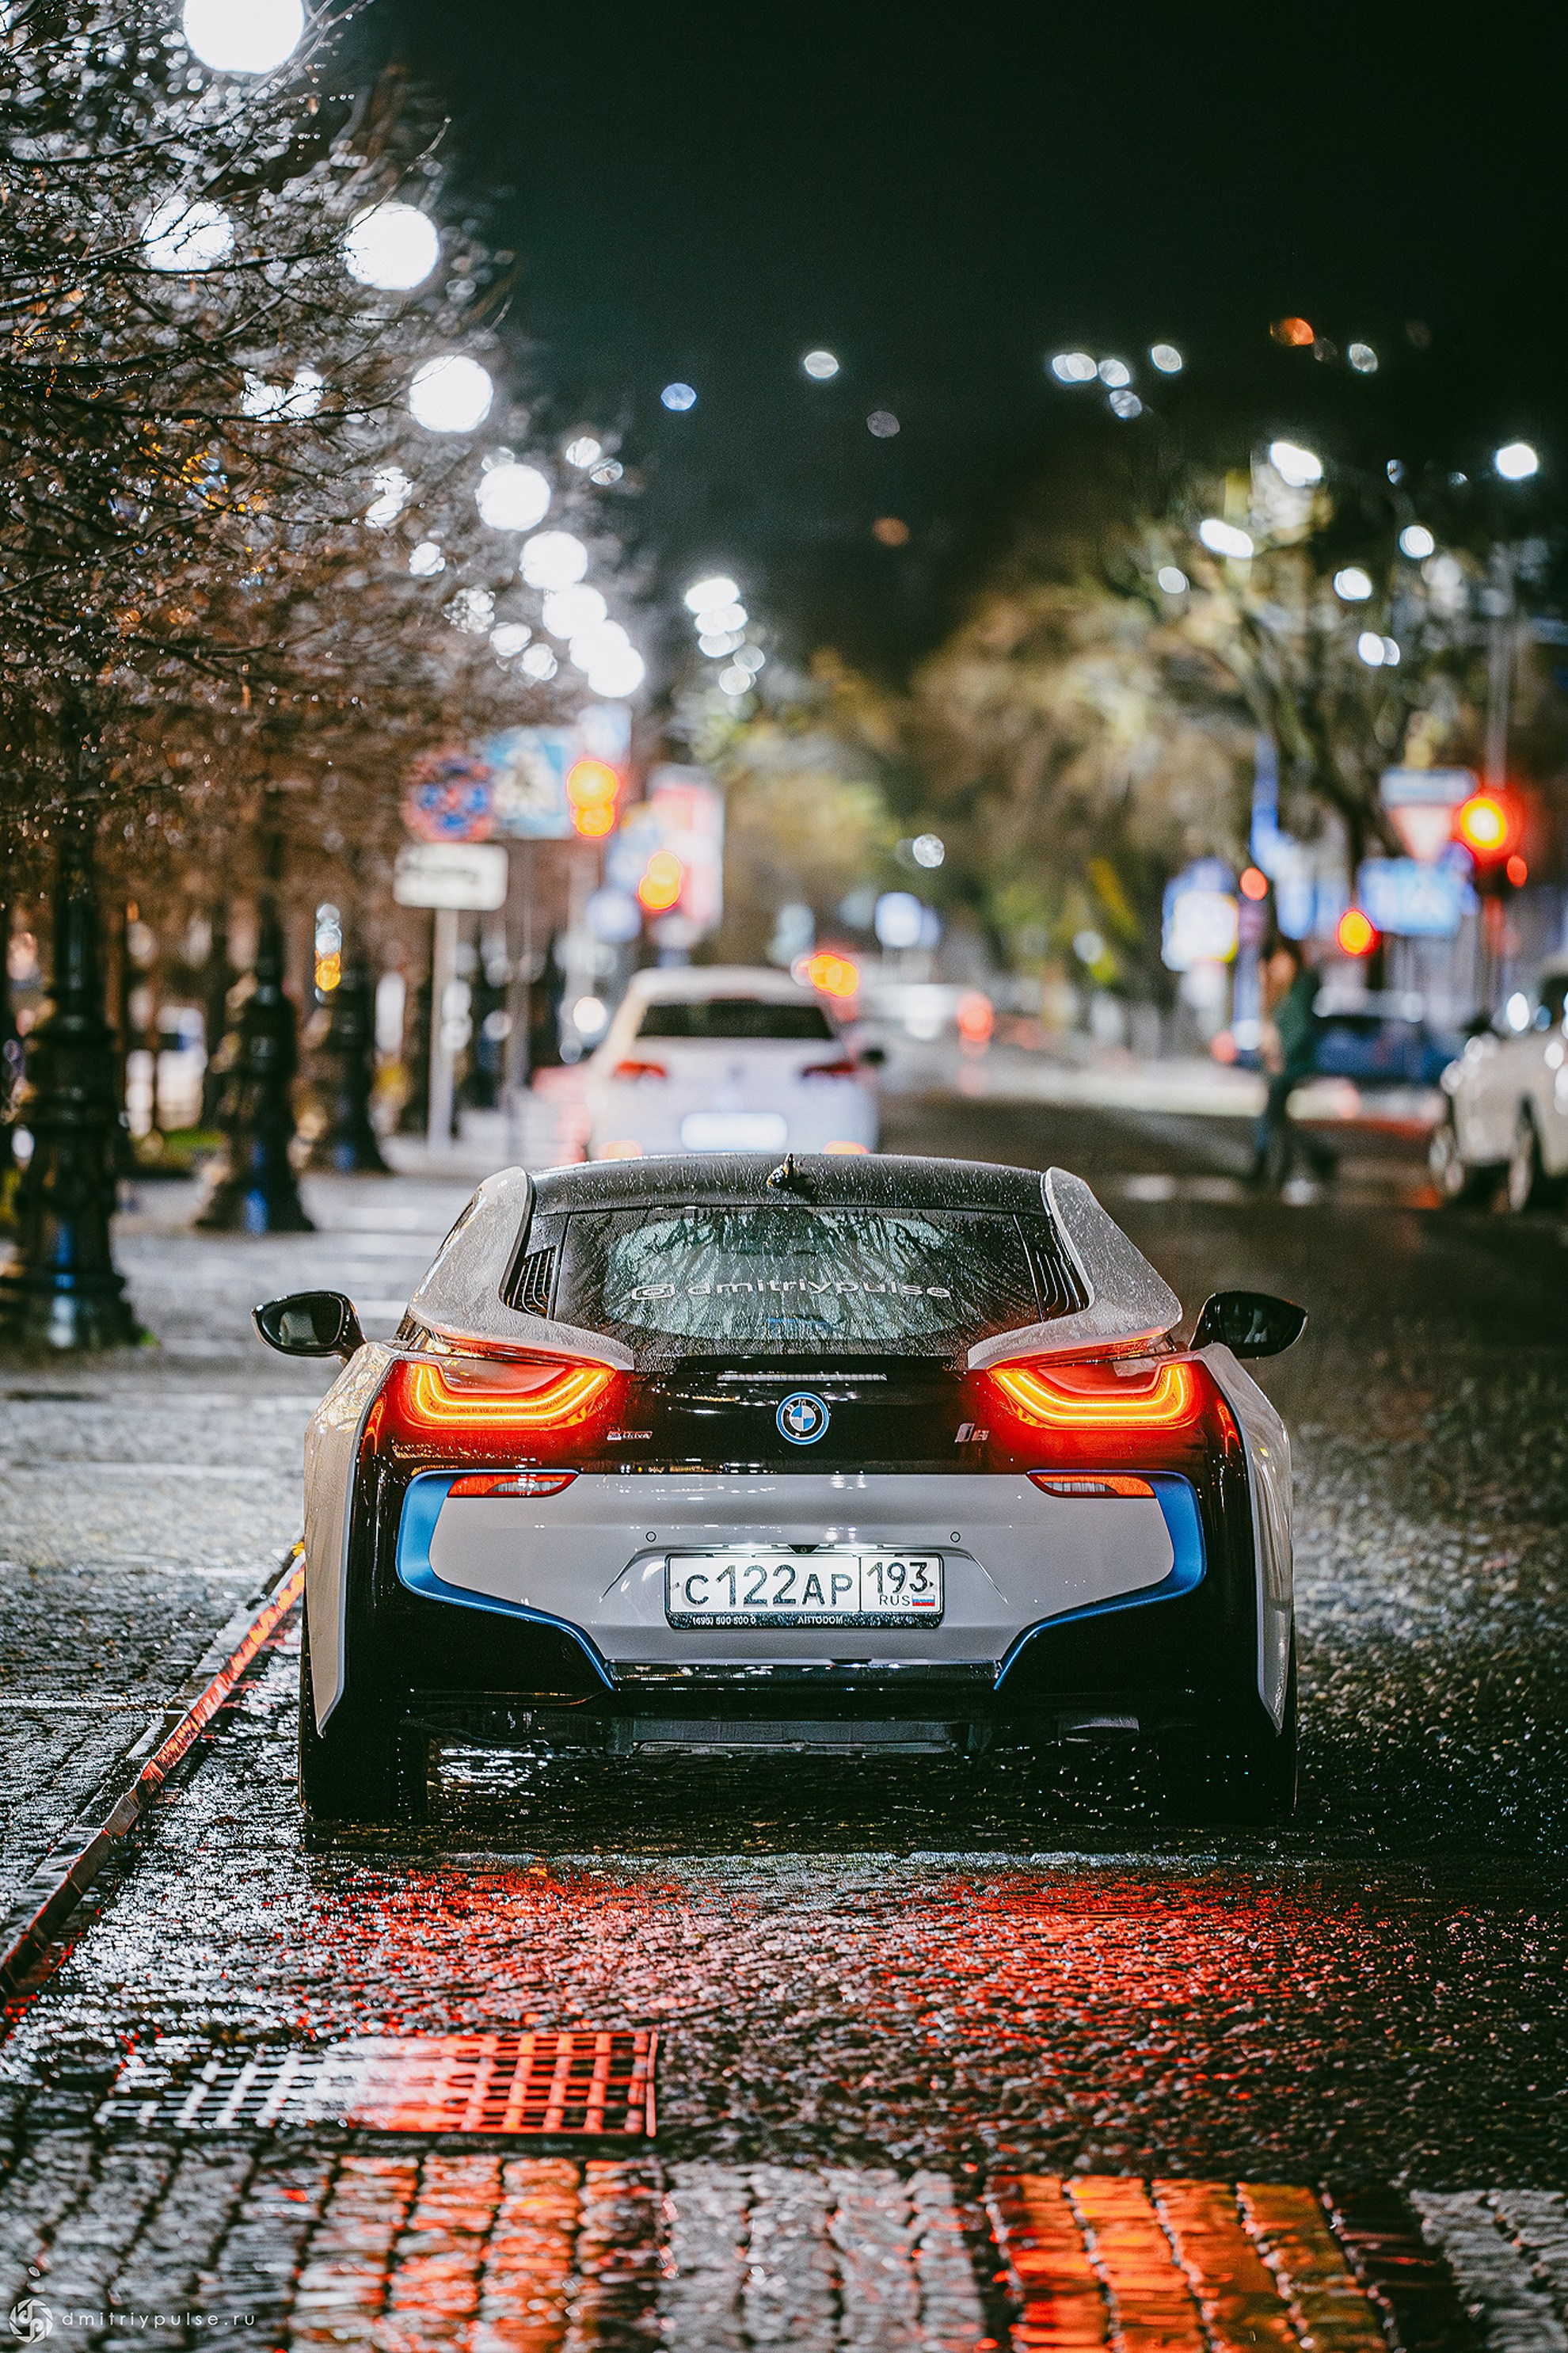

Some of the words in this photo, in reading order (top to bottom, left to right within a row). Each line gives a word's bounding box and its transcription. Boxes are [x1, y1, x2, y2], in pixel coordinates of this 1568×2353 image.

[687, 1276, 952, 1298] dmitriypulse
[685, 1564, 854, 1607] C122AP
[866, 1562, 929, 1593] 193
[879, 1594, 911, 1606] RUS
